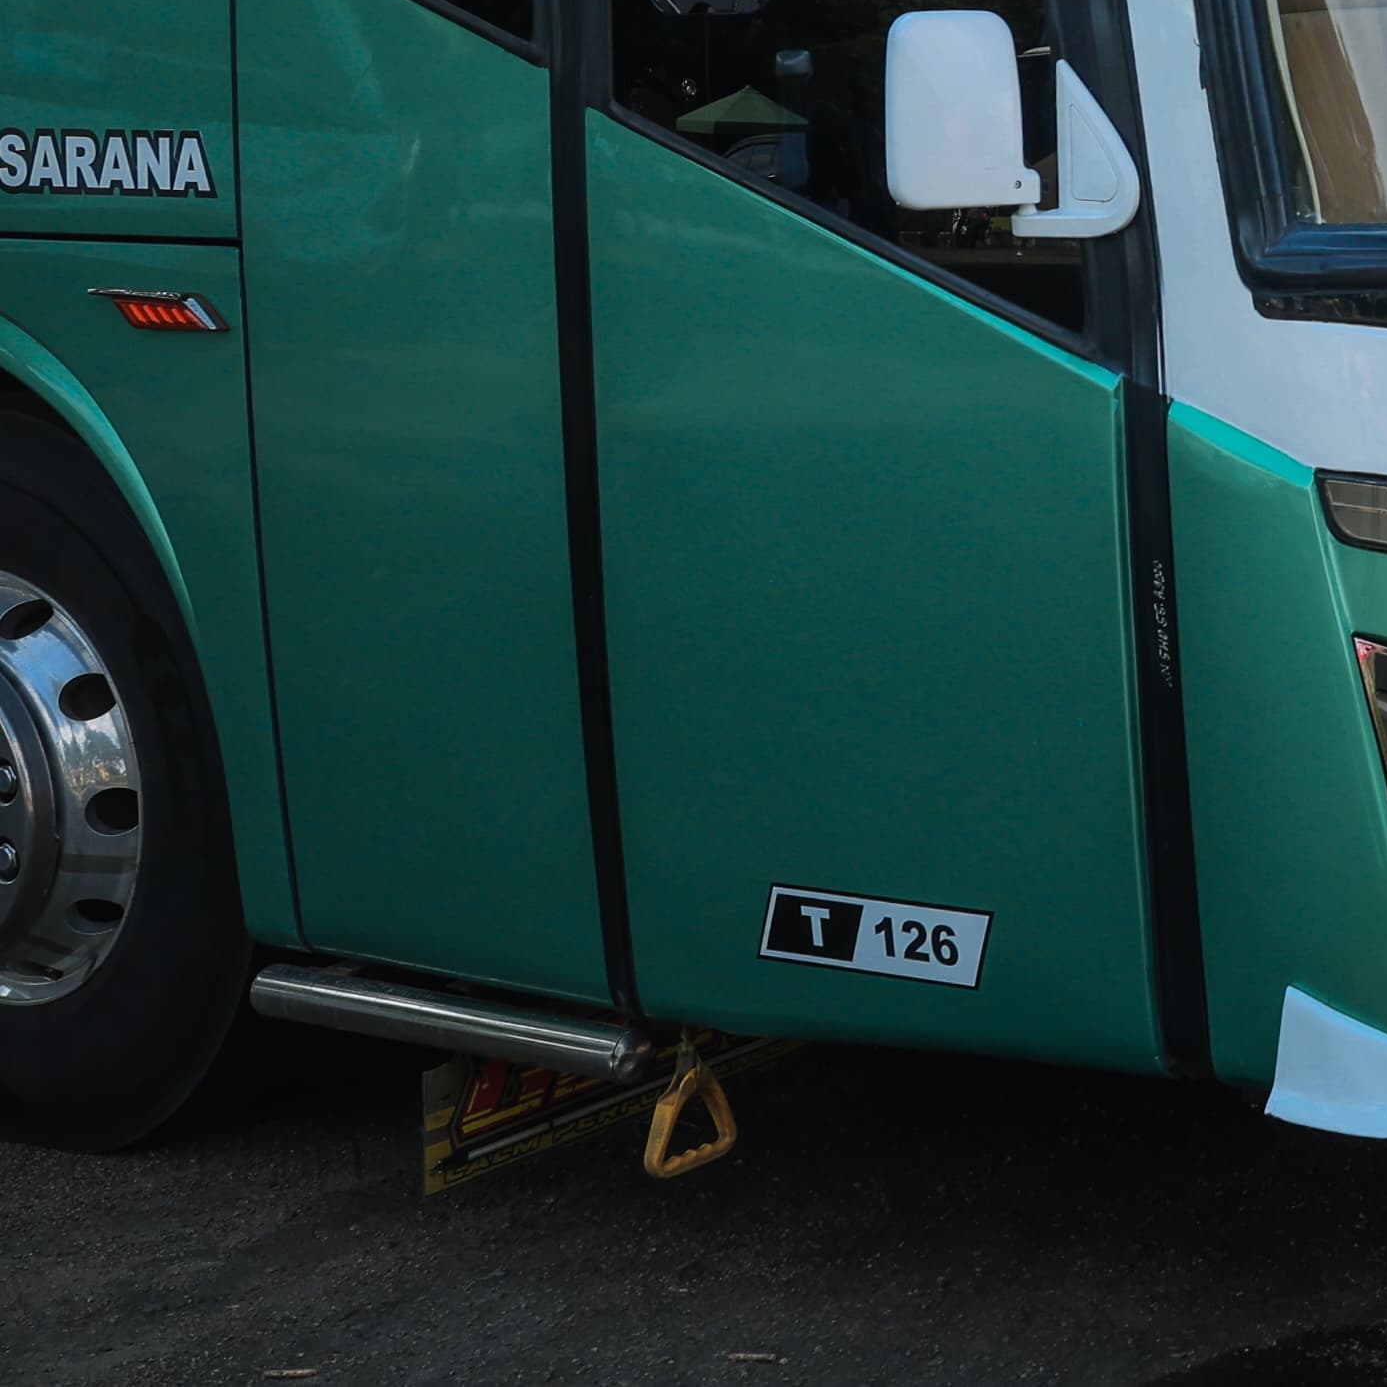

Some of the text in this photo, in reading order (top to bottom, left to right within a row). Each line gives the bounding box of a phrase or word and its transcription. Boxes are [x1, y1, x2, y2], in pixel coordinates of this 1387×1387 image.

[0, 133, 211, 191] SARANA
[801, 905, 959, 966] T 126
